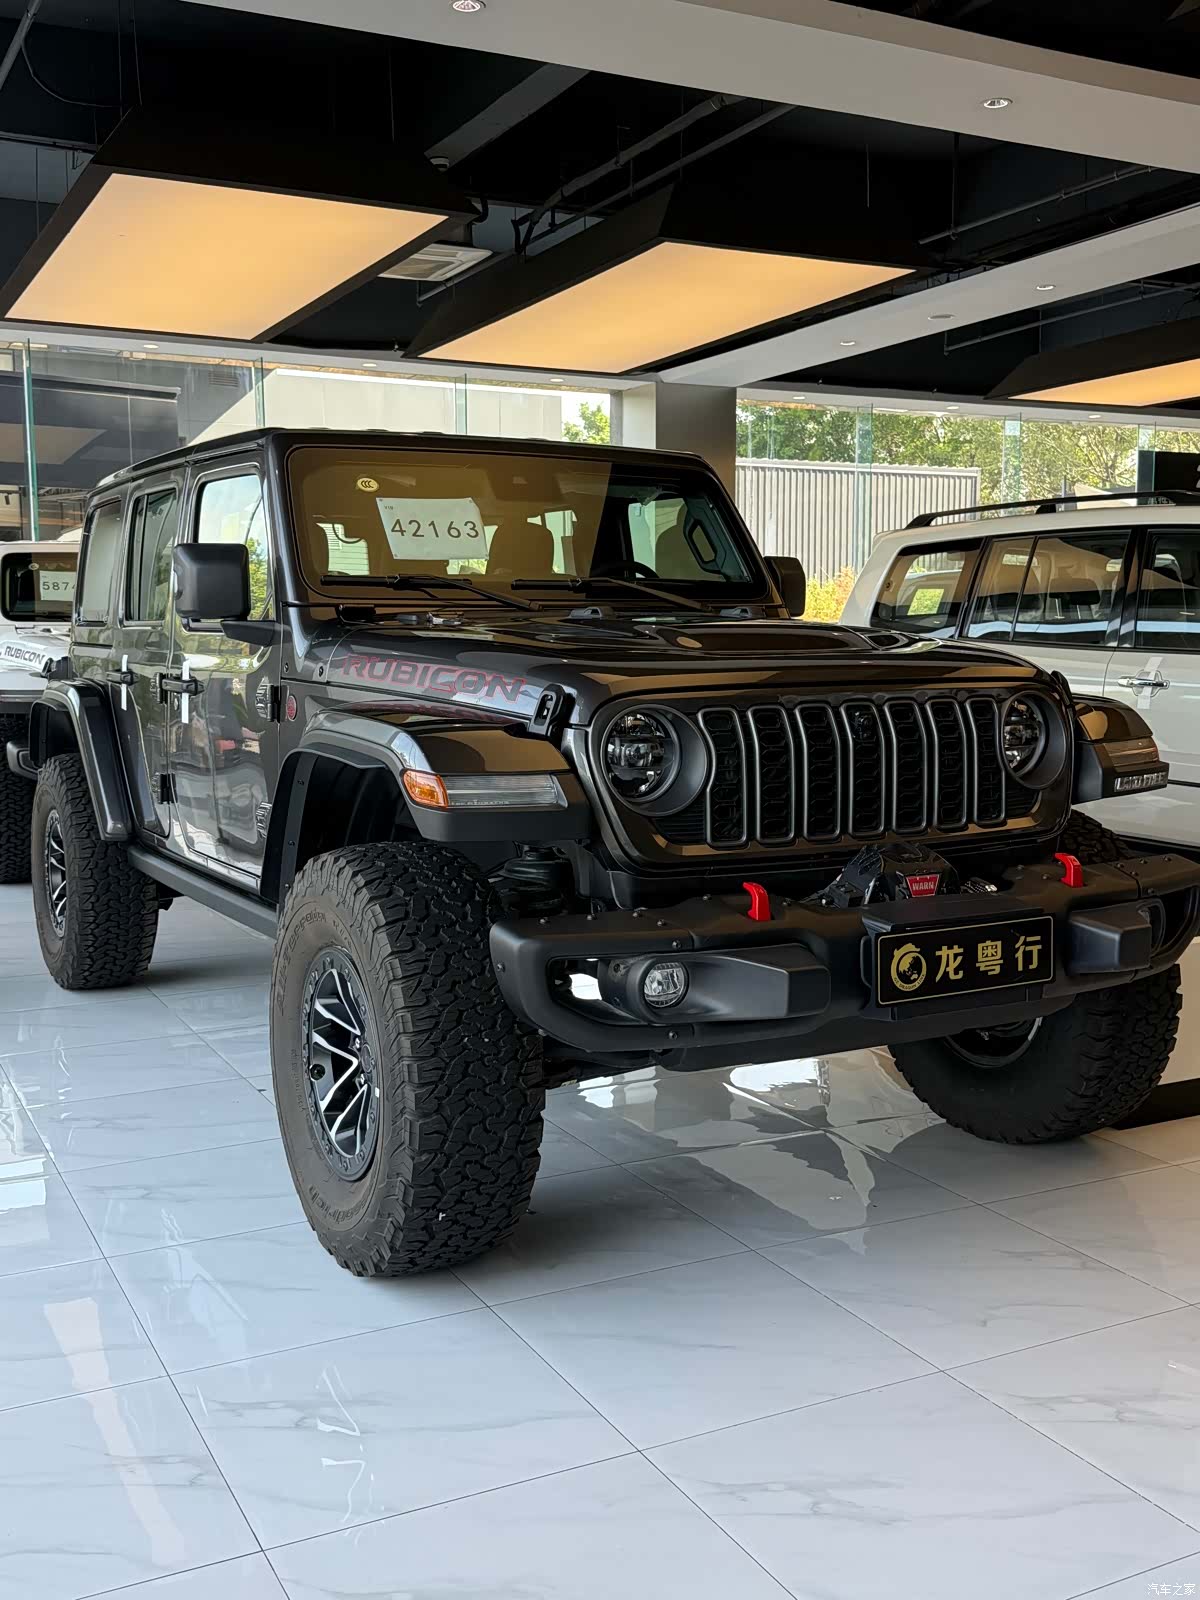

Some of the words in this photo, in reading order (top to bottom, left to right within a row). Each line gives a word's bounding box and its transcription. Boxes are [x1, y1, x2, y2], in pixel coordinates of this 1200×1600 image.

[391, 518, 479, 539] 42163
[4, 645, 45, 665] RUBICON
[341, 653, 527, 704] RUBICON
[912, 881, 935, 891] WARN
[935, 935, 1042, 983] 龙粤行
